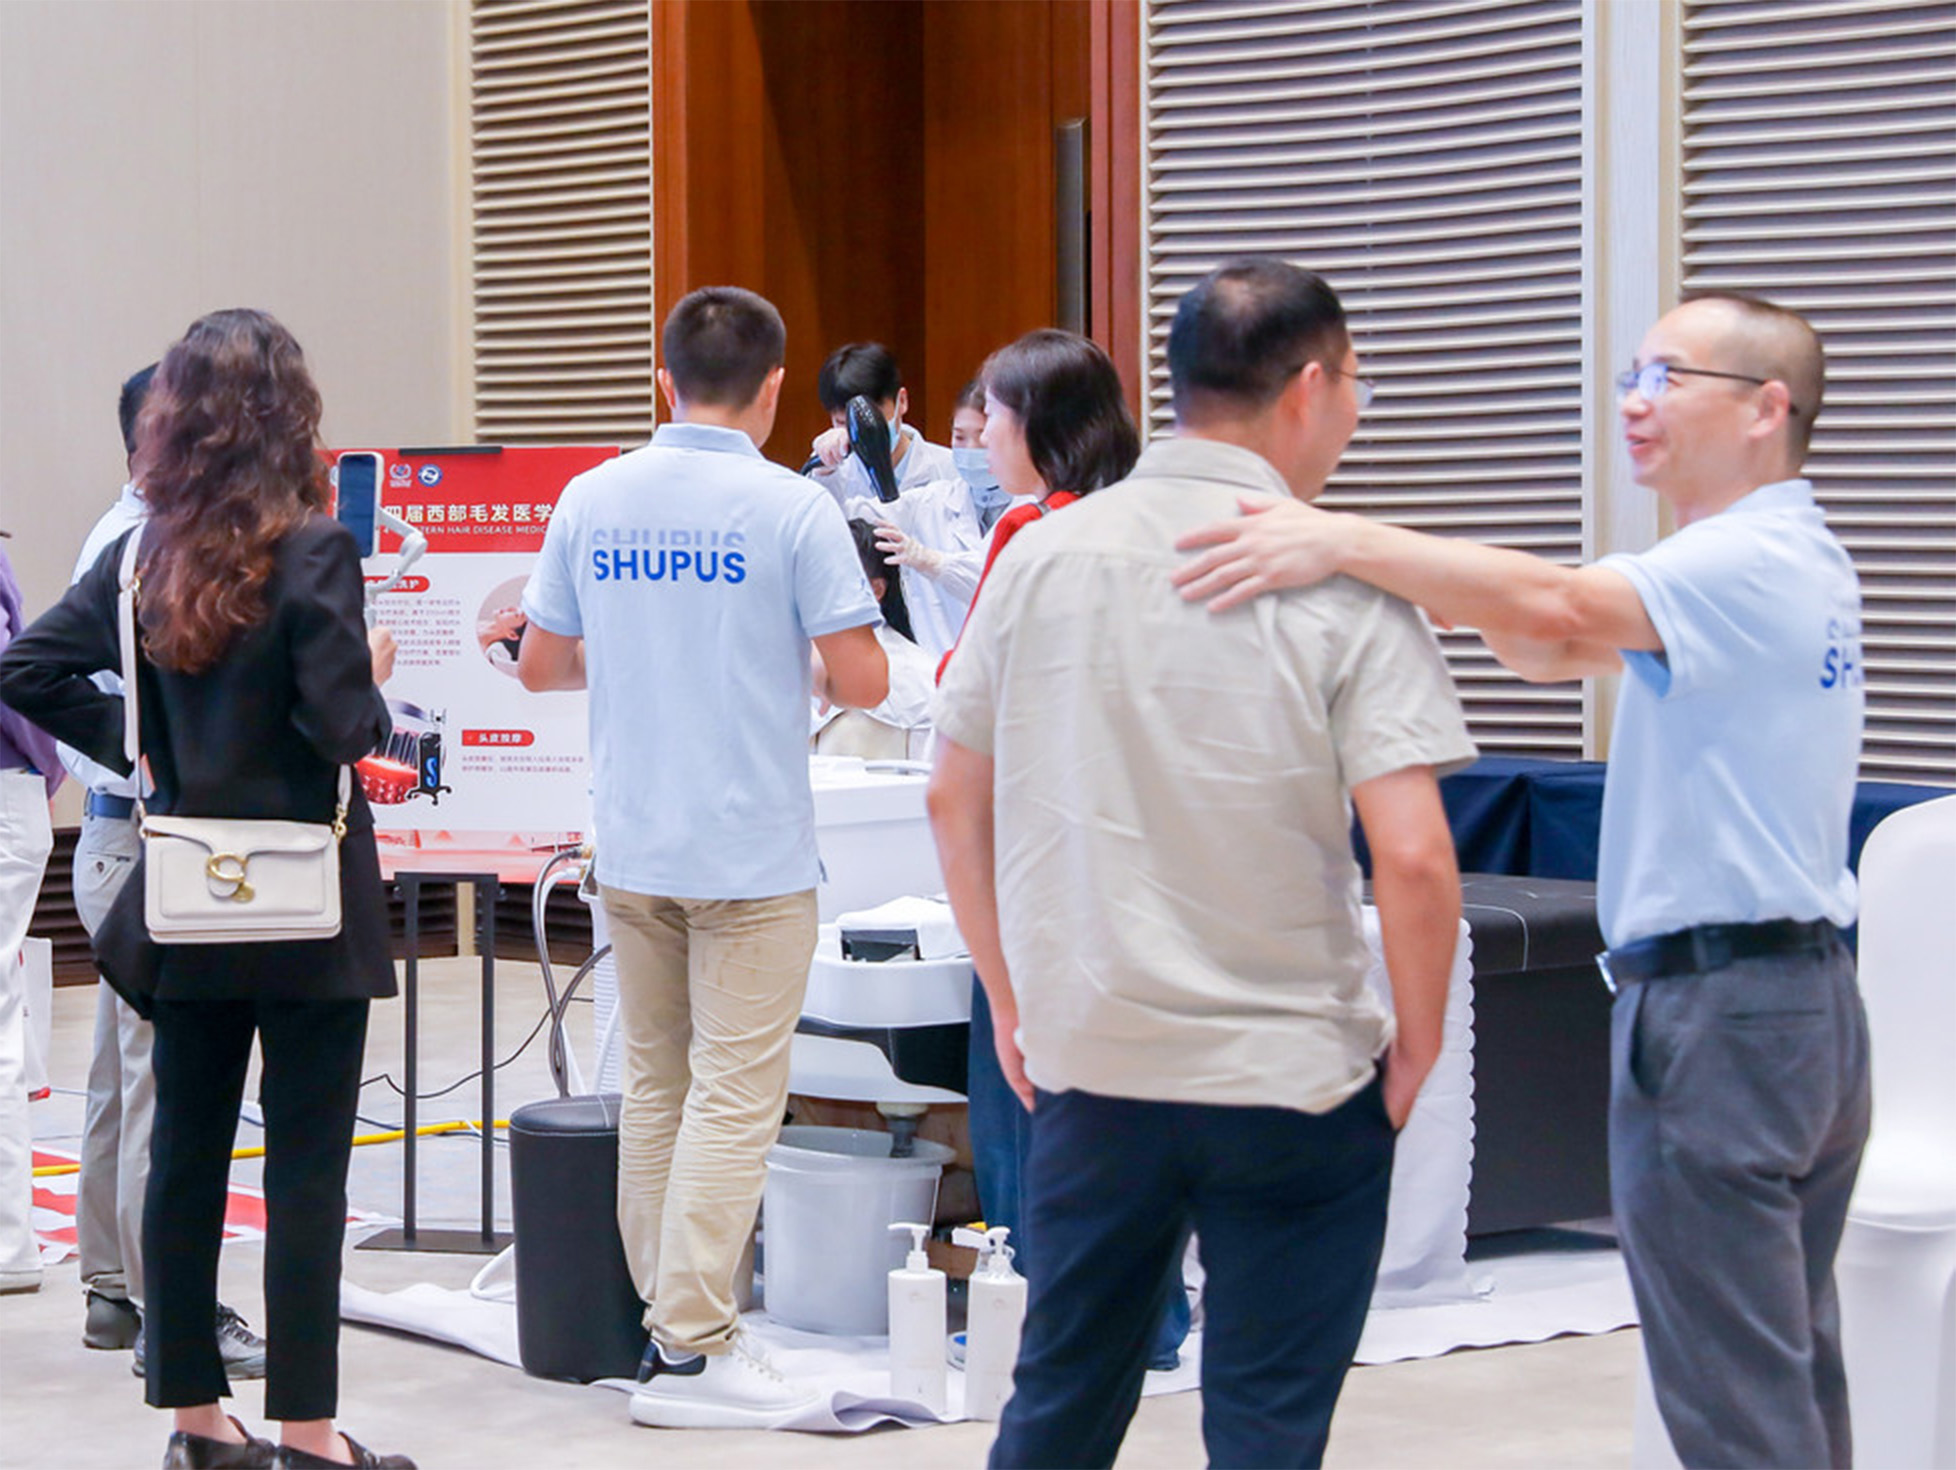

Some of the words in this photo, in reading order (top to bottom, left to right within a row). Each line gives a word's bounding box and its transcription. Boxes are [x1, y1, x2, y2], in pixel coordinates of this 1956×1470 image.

[447, 525, 471, 534] HAIR
[472, 525, 513, 534] DISEASE
[592, 549, 747, 584] SHUPUS
